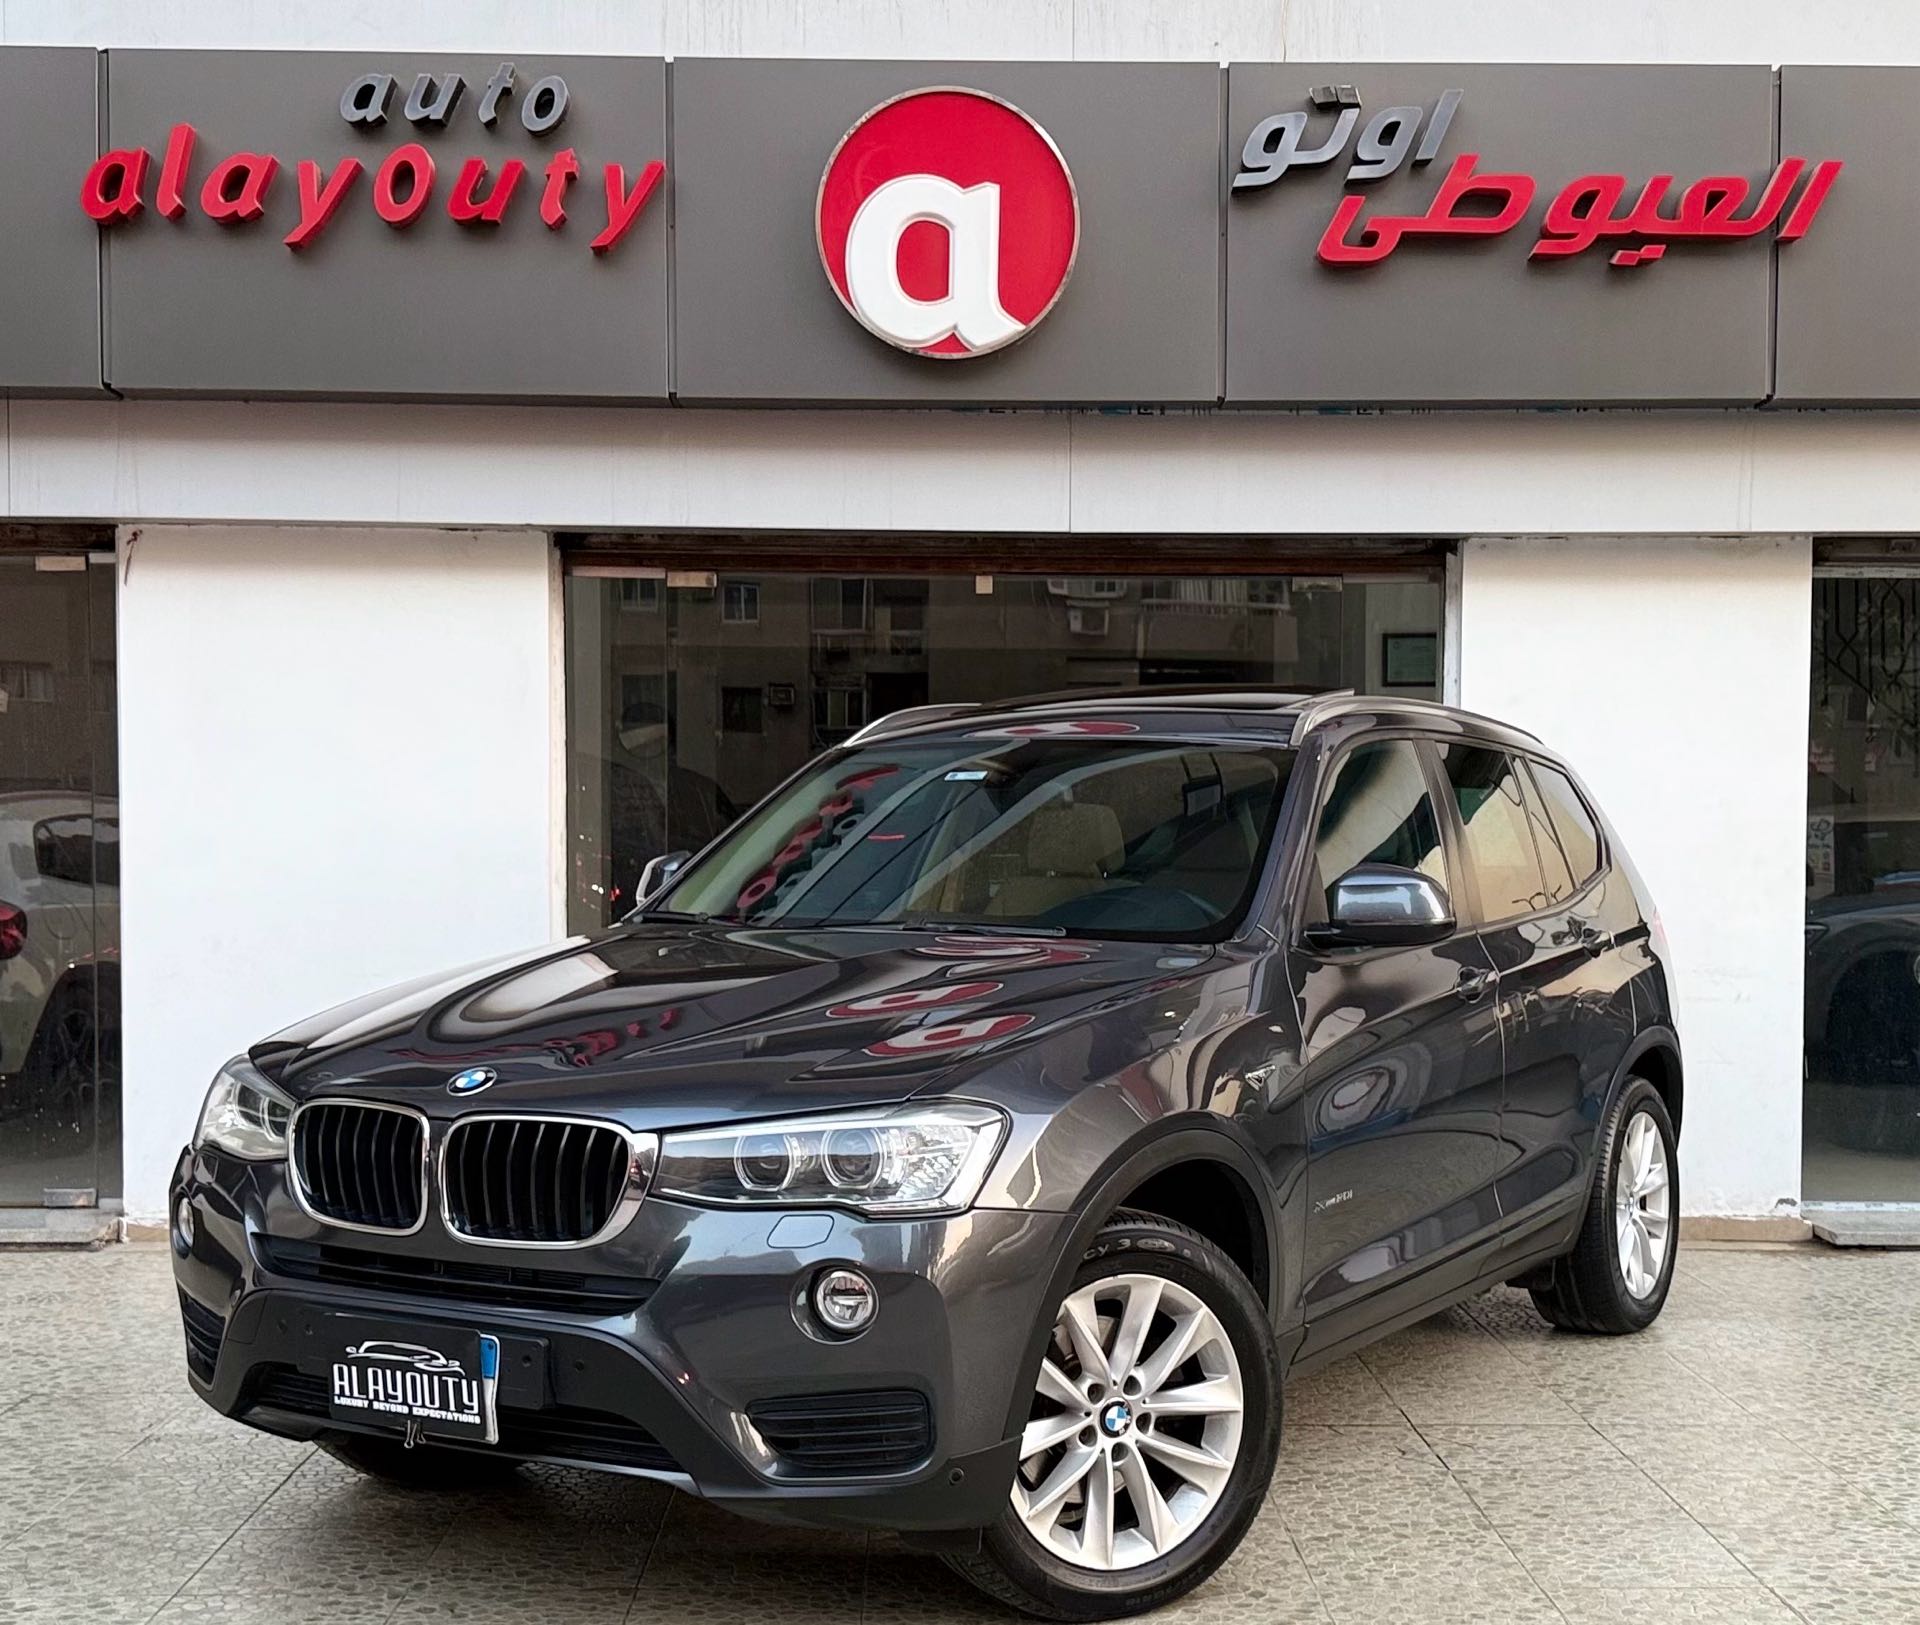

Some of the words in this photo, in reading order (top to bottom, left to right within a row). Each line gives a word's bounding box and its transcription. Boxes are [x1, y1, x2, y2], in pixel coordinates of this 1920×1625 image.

[340, 62, 571, 136] auto
[845, 173, 1027, 352] a
[332, 1363, 480, 1415] ALAYOUTY
[372, 1400, 410, 1415] BEYOND
[412, 1406, 482, 1425] EXPECTATIONS
